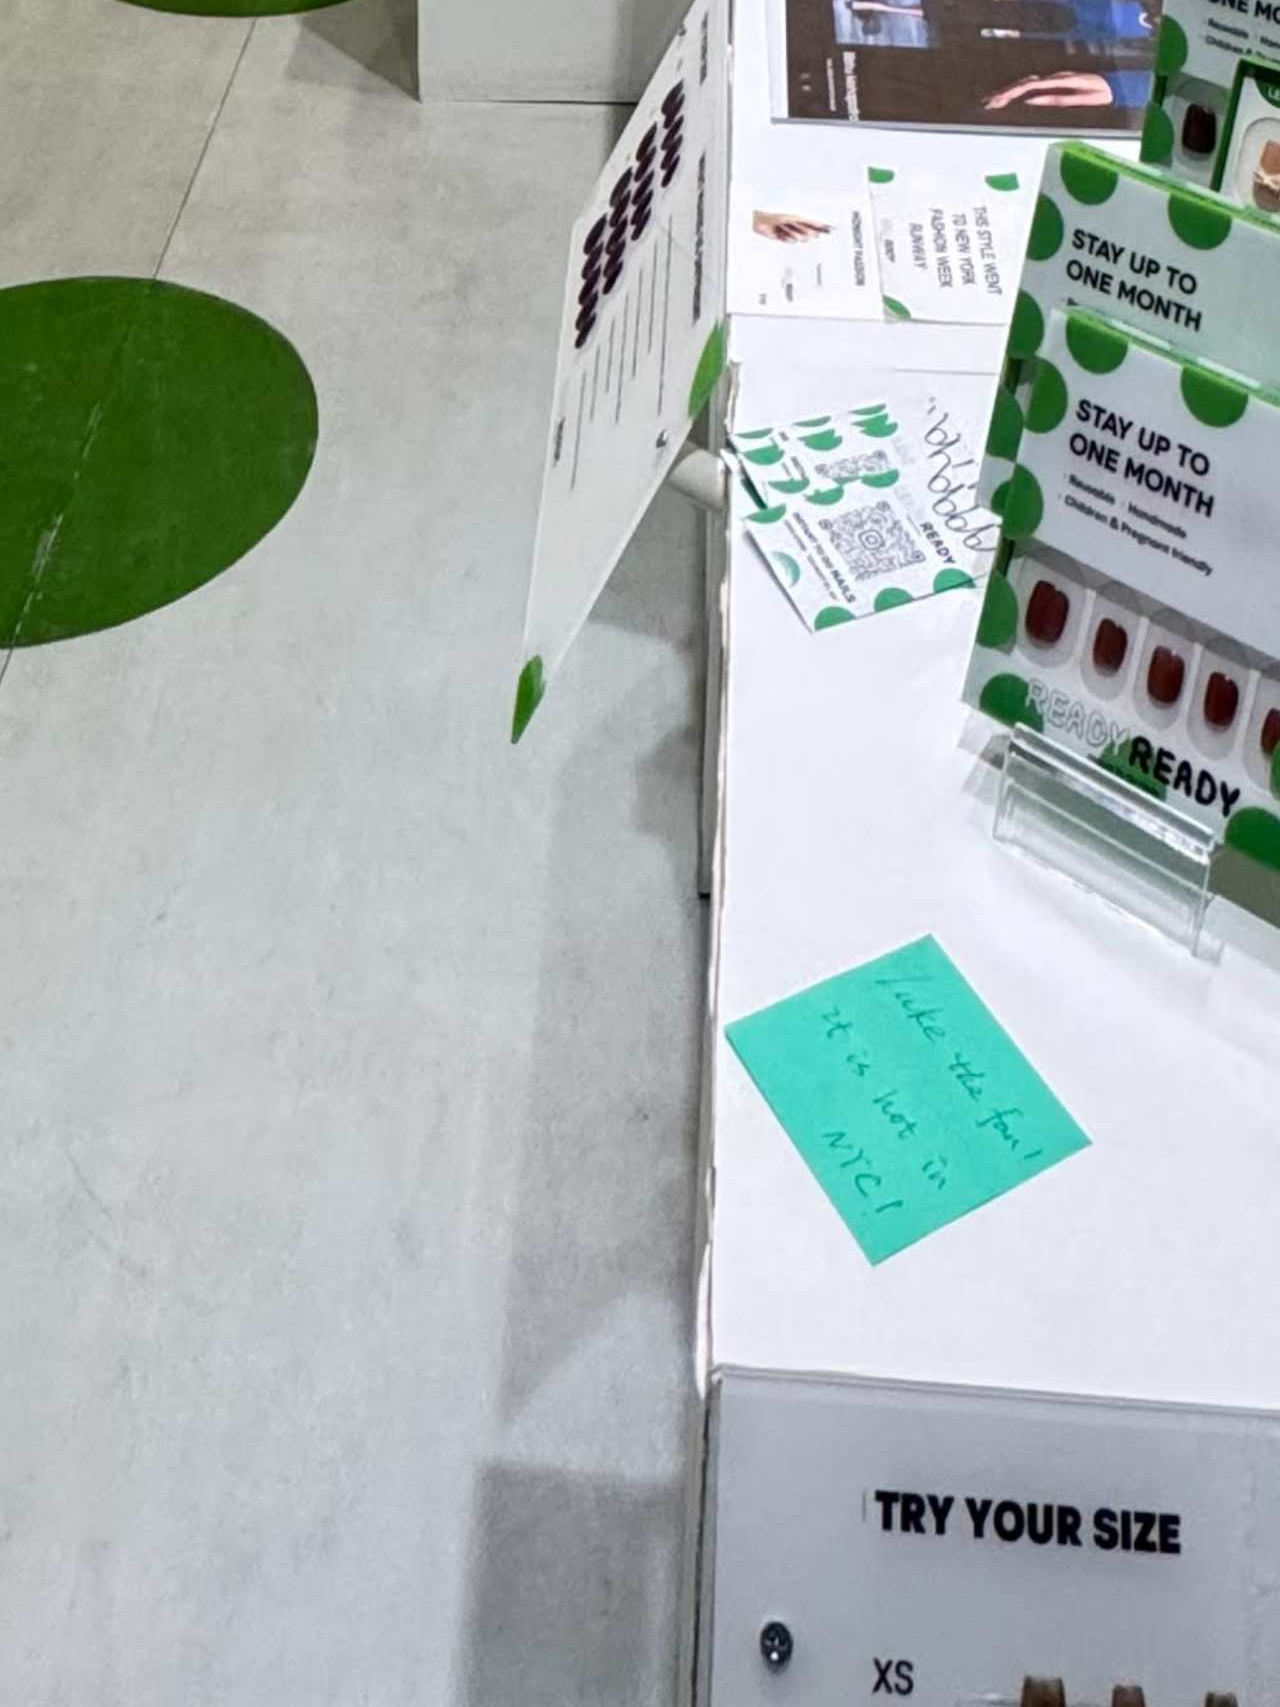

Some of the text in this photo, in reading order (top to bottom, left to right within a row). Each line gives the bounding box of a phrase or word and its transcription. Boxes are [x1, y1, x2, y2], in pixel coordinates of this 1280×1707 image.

[976, 229, 997, 261] STYLE
[1071, 228, 1197, 295] STAY UP TO
[983, 262, 1004, 296] WENT
[1066, 258, 1202, 332] ONE MONTH
[1075, 398, 1210, 477] STAY UP TO
[1069, 432, 1214, 518] ONE MONTH
[1069, 473, 1188, 540] Reusable Handmade
[919, 520, 957, 566] READY
[1064, 494, 1214, 577] Children & Pregnant friendly
[831, 568, 857, 604] NAILS
[1025, 678, 1241, 818] READY READY
[947, 1050, 986, 1105] the
[845, 1049, 872, 1079] is
[871, 1089, 921, 1141] hot
[920, 1153, 949, 1192] in
[873, 1488, 1183, 1556] TRY YOUR SIZE
[870, 1656, 916, 1697] XS
